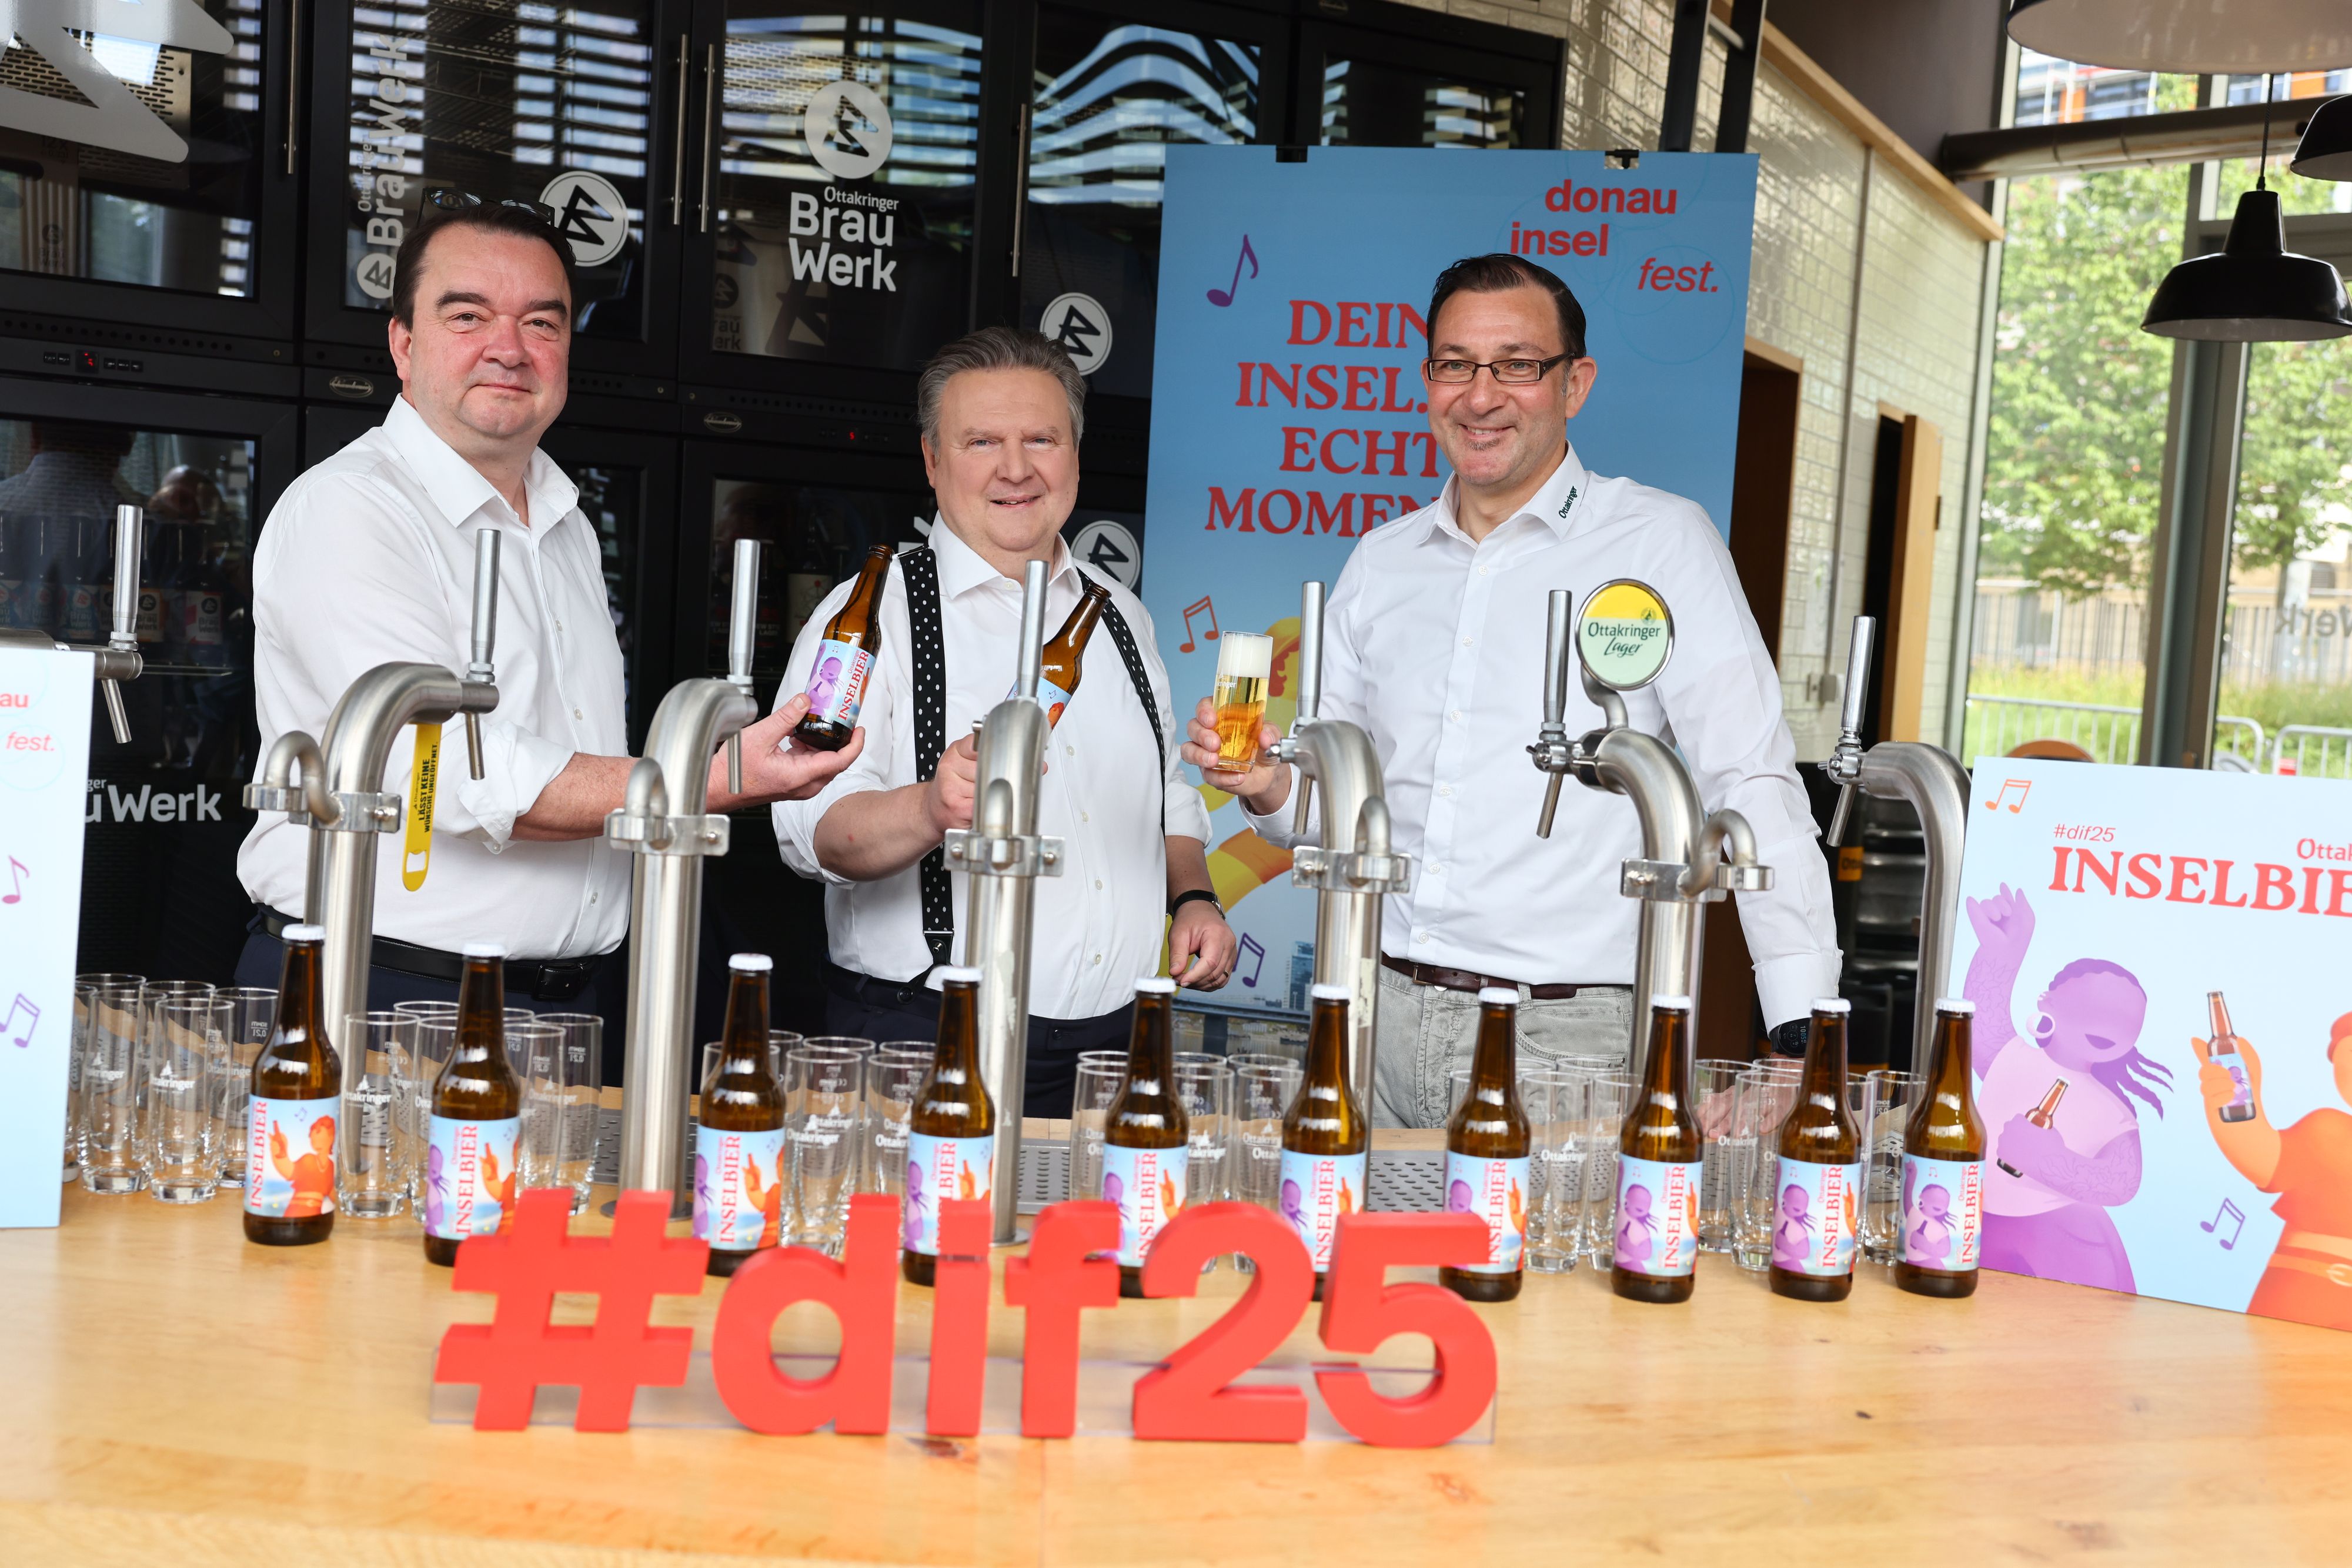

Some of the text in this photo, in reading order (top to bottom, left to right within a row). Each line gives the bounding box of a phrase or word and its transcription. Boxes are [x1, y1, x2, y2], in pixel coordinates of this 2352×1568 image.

[789, 192, 894, 247] Brau
[824, 186, 899, 212] Ottakringer
[1545, 179, 1678, 215] donau
[1509, 221, 1609, 257] insel
[789, 237, 897, 292] Werk
[1637, 257, 1719, 293] fest.
[1287, 300, 1429, 349] DEIN
[1235, 362, 1428, 413] INSEL.
[1559, 486, 1577, 519] Ottakringer
[1588, 622, 1661, 640] Ottakringer
[1604, 637, 1643, 658] Lager
[0, 693, 29, 708] au
[838, 651, 869, 721] INSELBIER
[6, 731, 55, 751] fest.
[85, 784, 222, 823] uWerk
[2052, 823, 2116, 843] #dif25
[2048, 845, 2352, 918] INSELBIE
[456, 1125, 479, 1234] INSELBIER
[720, 1135, 741, 1243] INSELBIER
[1316, 1160, 1335, 1265] INSELBIER
[1665, 1166, 1686, 1268] INSELBIER
[1823, 1166, 1843, 1268] INSELBIER
[1962, 1164, 1979, 1264] INSELBIER
[434, 1188, 1498, 1447] #dif25
